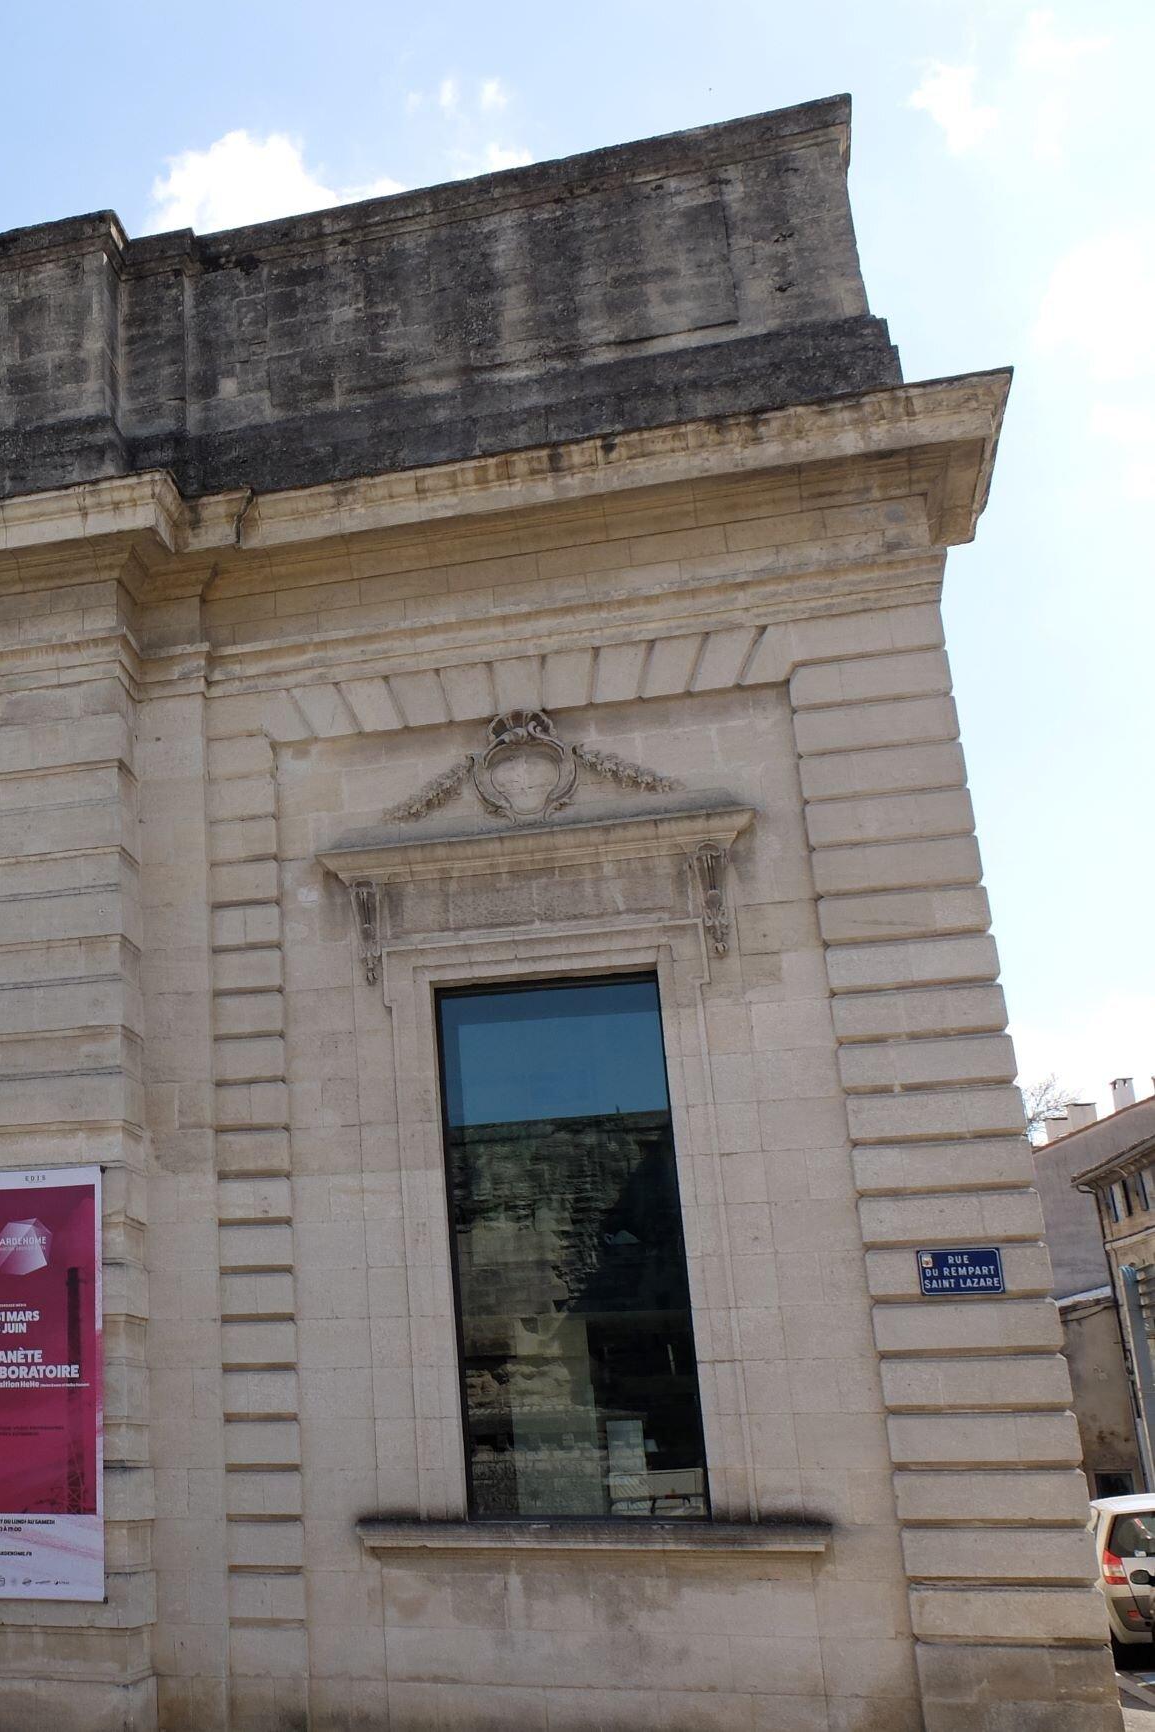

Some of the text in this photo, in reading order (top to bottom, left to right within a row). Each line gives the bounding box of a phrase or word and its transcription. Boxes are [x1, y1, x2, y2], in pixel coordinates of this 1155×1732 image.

[948, 1255, 969, 1264] RUE
[925, 1266, 994, 1277] DU REMPART
[924, 1278, 1000, 1288] SAINT LAZARE
[6, 1310, 40, 1322] MARS
[1, 1322, 27, 1334] JUIN
